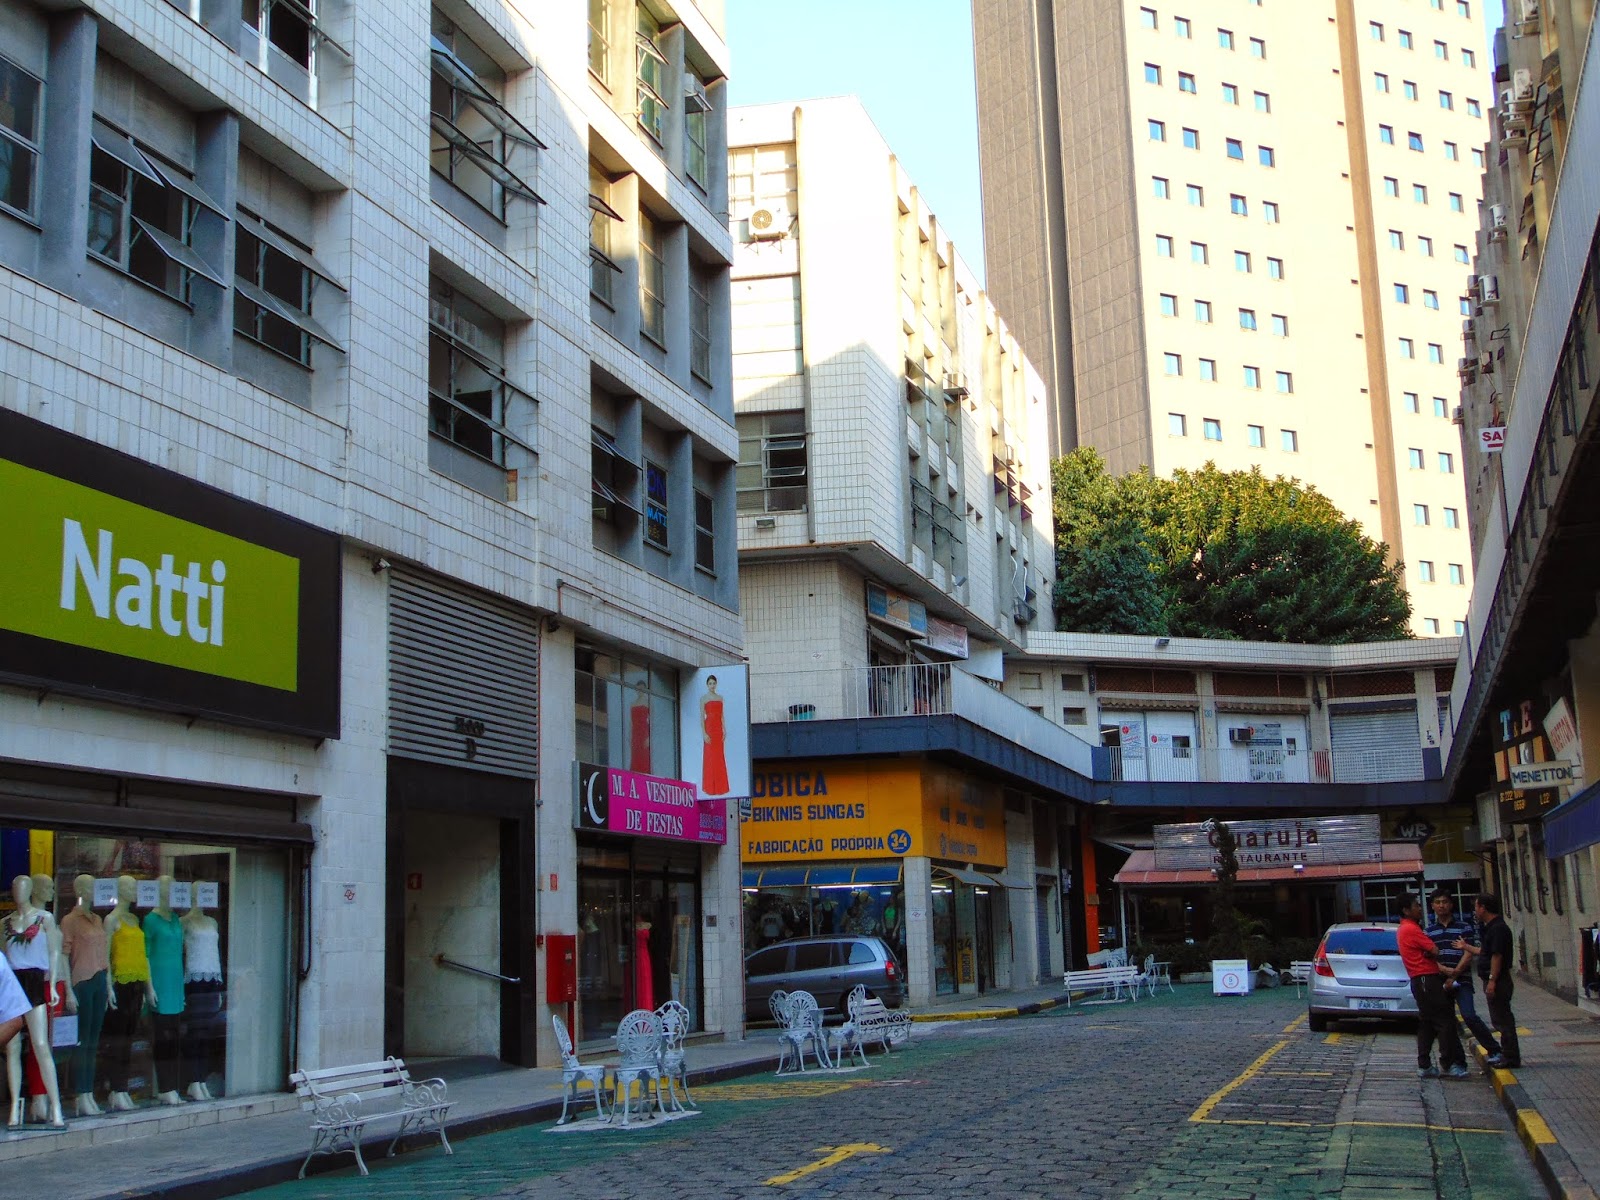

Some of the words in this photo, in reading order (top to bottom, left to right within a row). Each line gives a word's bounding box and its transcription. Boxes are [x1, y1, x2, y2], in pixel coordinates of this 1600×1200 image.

[60, 518, 226, 647] Natti
[1512, 767, 1572, 783] MENETTON
[612, 774, 625, 797] M.
[629, 778, 639, 799] A.
[646, 780, 694, 808] VESTIDOS
[752, 805, 803, 822] BIKINIS
[807, 803, 865, 820] SUNGAS
[626, 808, 642, 831] DE
[646, 811, 684, 836] FESTAS
[748, 838, 823, 854] FABRICAÇÃO
[890, 833, 908, 849] 34
[1213, 853, 1307, 863] RTAURANTE
